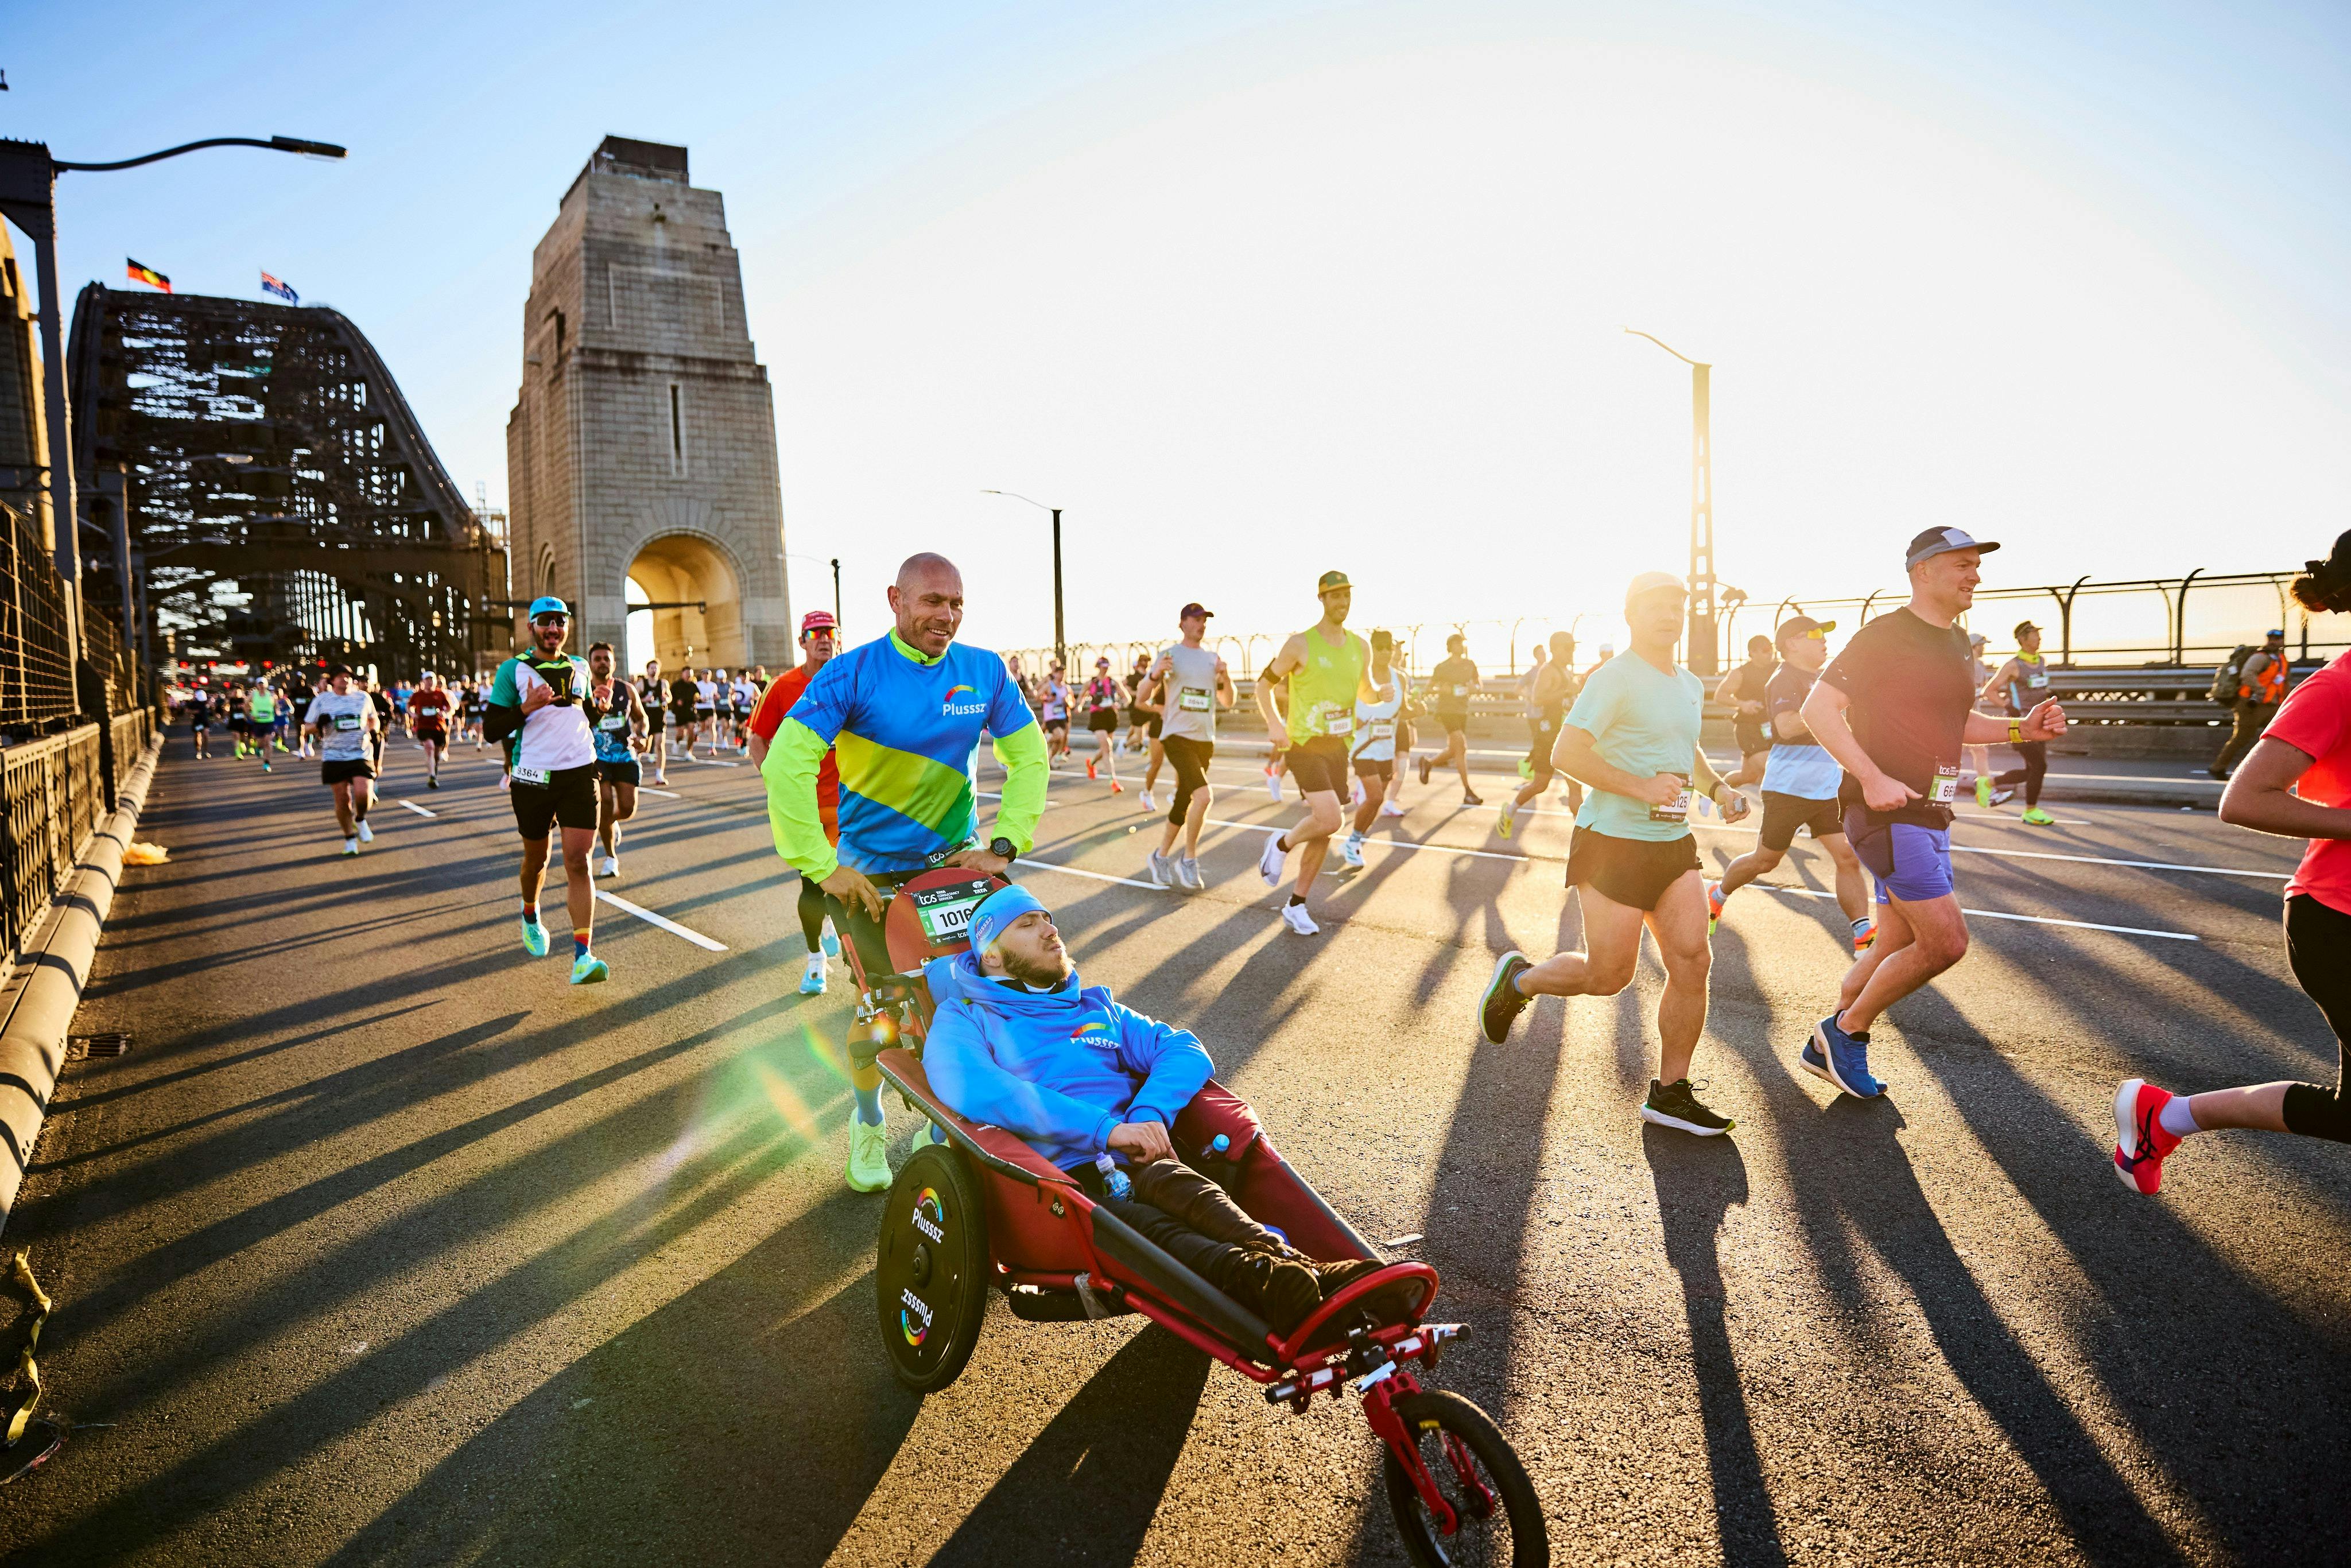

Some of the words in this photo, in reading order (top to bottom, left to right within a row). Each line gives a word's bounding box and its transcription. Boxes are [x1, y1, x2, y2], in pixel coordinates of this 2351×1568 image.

[942, 703, 985, 716] Plusssz
[1939, 764, 1950, 775] tcs
[929, 852, 945, 863] tcs
[918, 894, 937, 905] tcs
[975, 914, 993, 940] Plusssz
[911, 1207, 942, 1244] Plusssz
[902, 1288, 933, 1328] Plusssz
